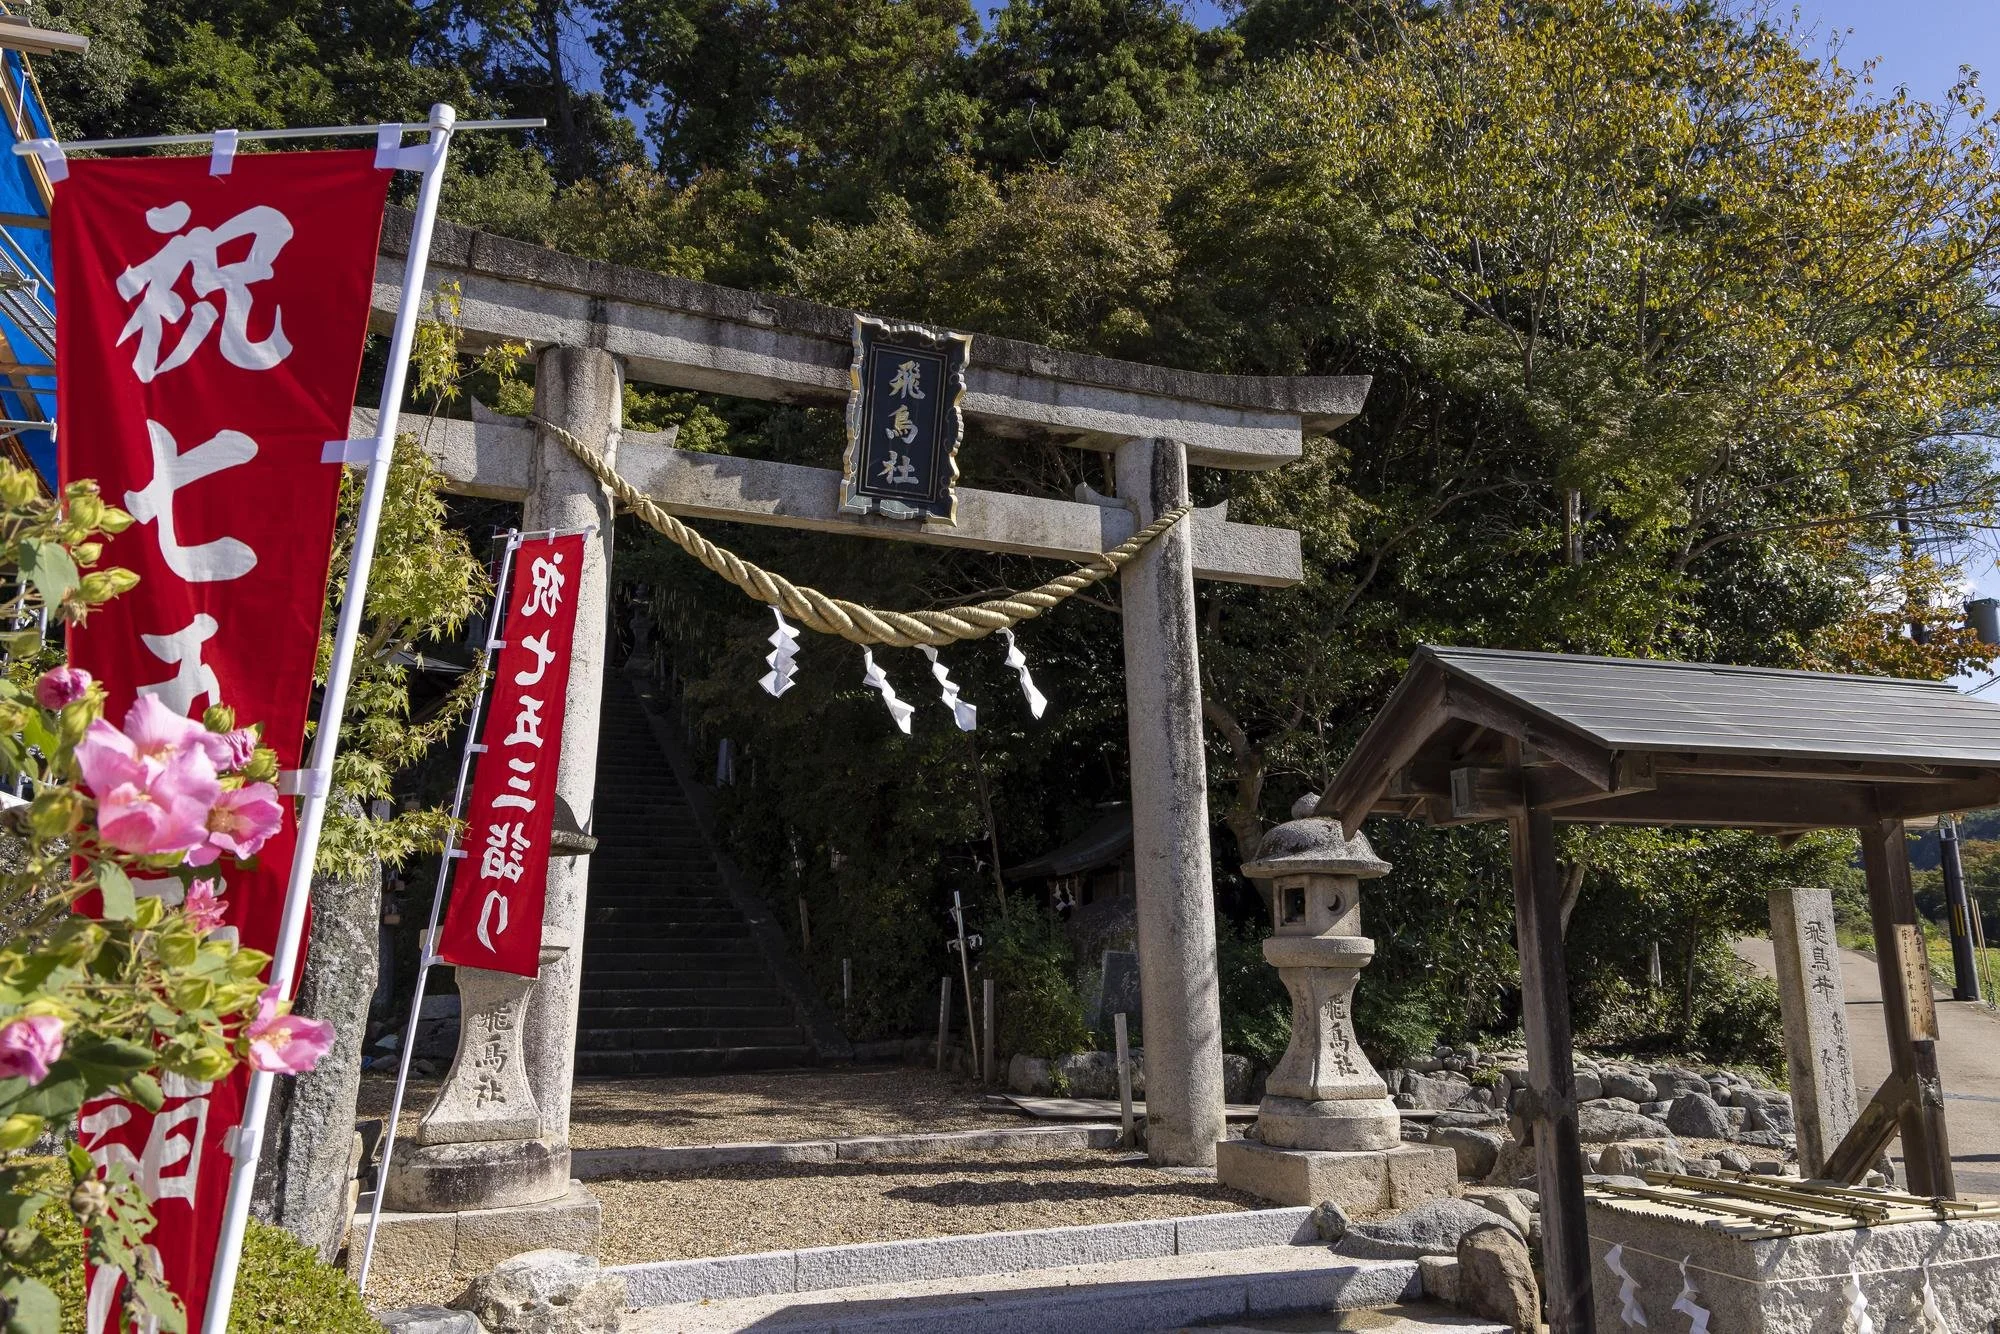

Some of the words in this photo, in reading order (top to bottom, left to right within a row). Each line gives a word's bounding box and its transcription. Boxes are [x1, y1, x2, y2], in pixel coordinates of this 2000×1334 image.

[877, 360, 926, 485] 飛鳥社
[1804, 920, 1834, 1004] 飛鳥井
[472, 1001, 514, 1108] 飛鳥社
